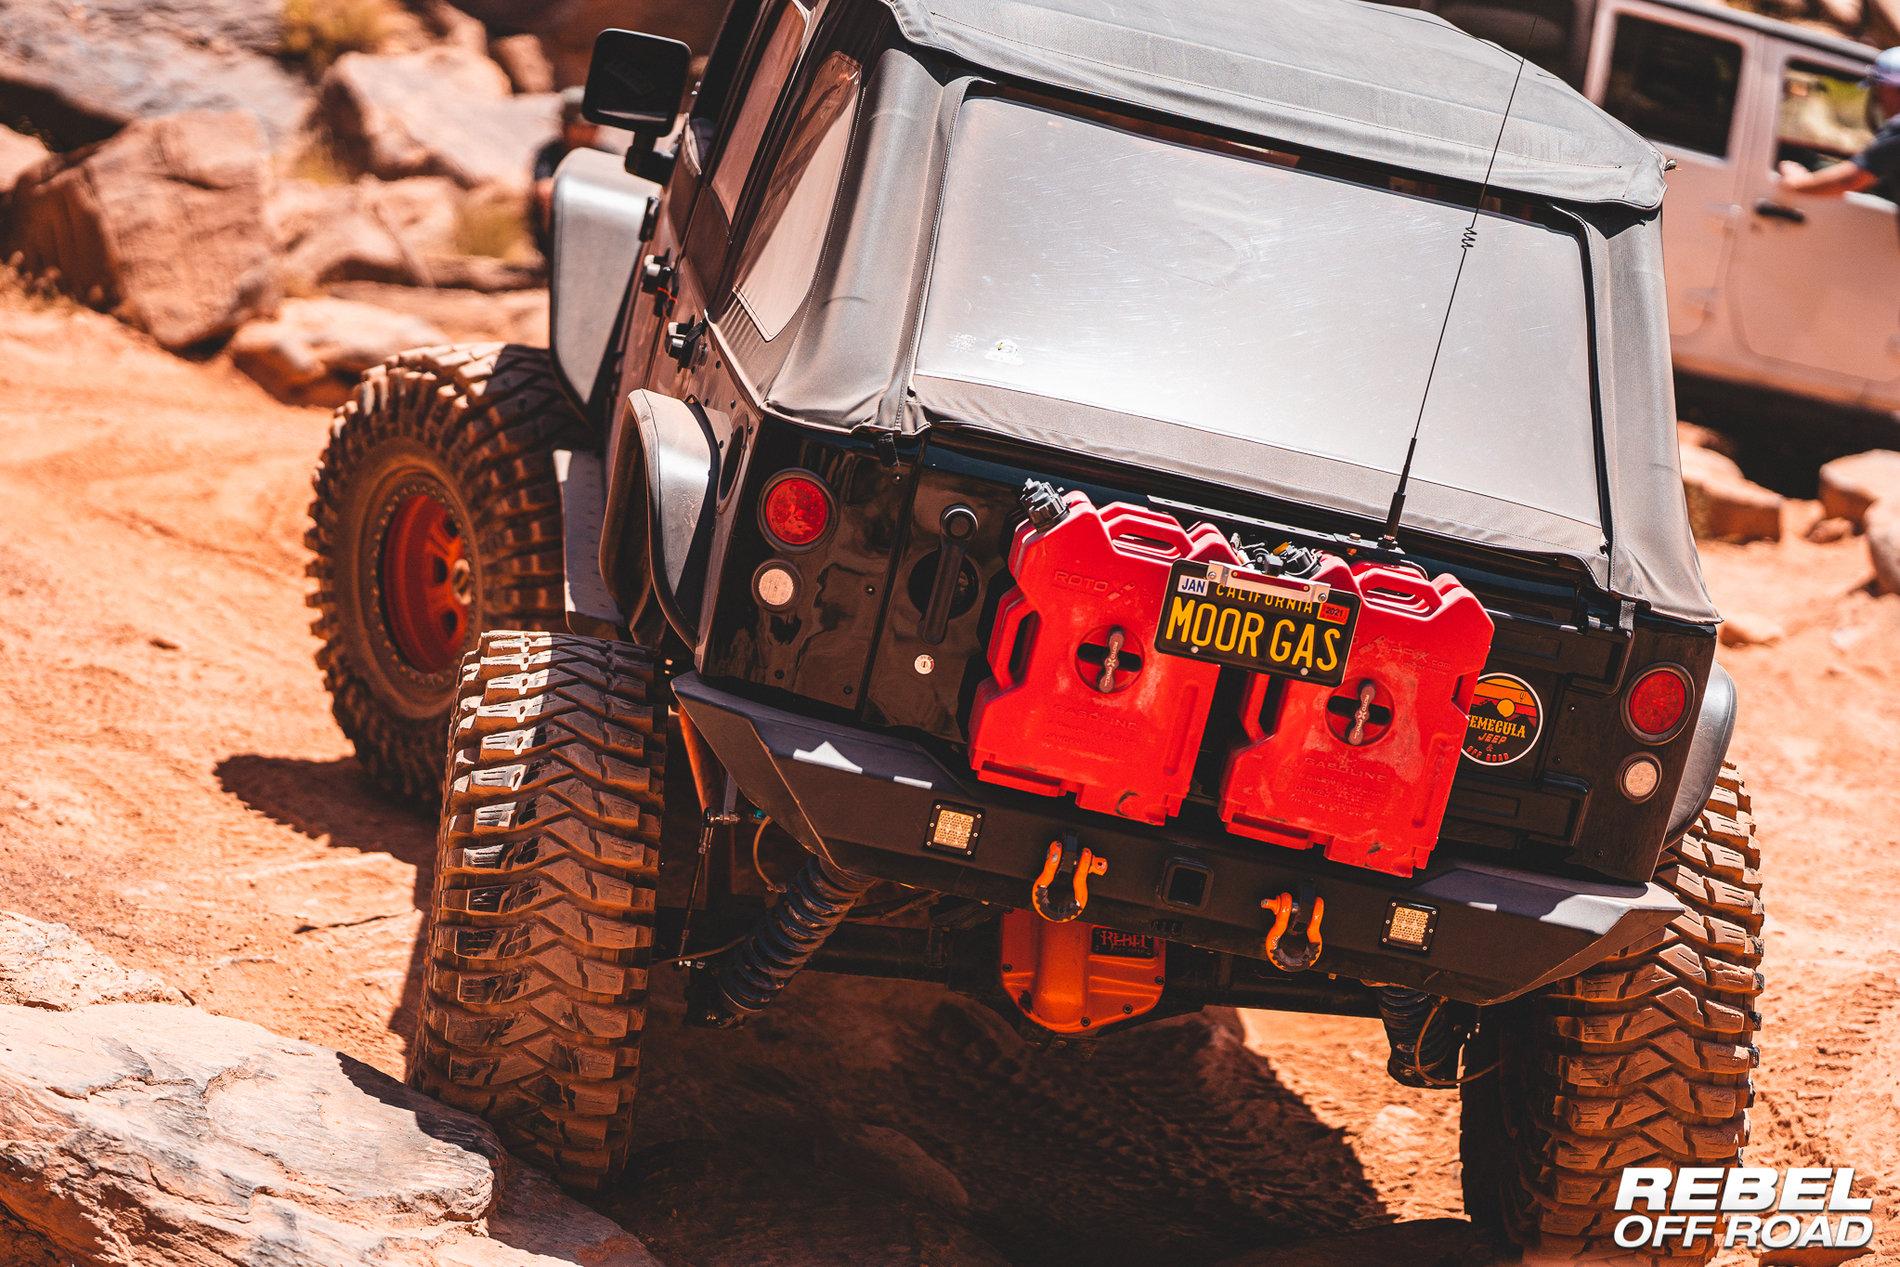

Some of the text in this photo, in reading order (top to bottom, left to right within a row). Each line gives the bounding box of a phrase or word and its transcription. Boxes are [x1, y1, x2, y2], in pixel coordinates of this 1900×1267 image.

[1181, 578, 1205, 593] JAN
[1216, 583, 1314, 614] CALIFORNIA
[1325, 606, 1343, 617] 2021
[1165, 596, 1341, 671] MOOR GAS
[1468, 714, 1526, 739] EMECULA
[1478, 732, 1507, 745] JEEP
[1304, 757, 1387, 783] GASOLINE
